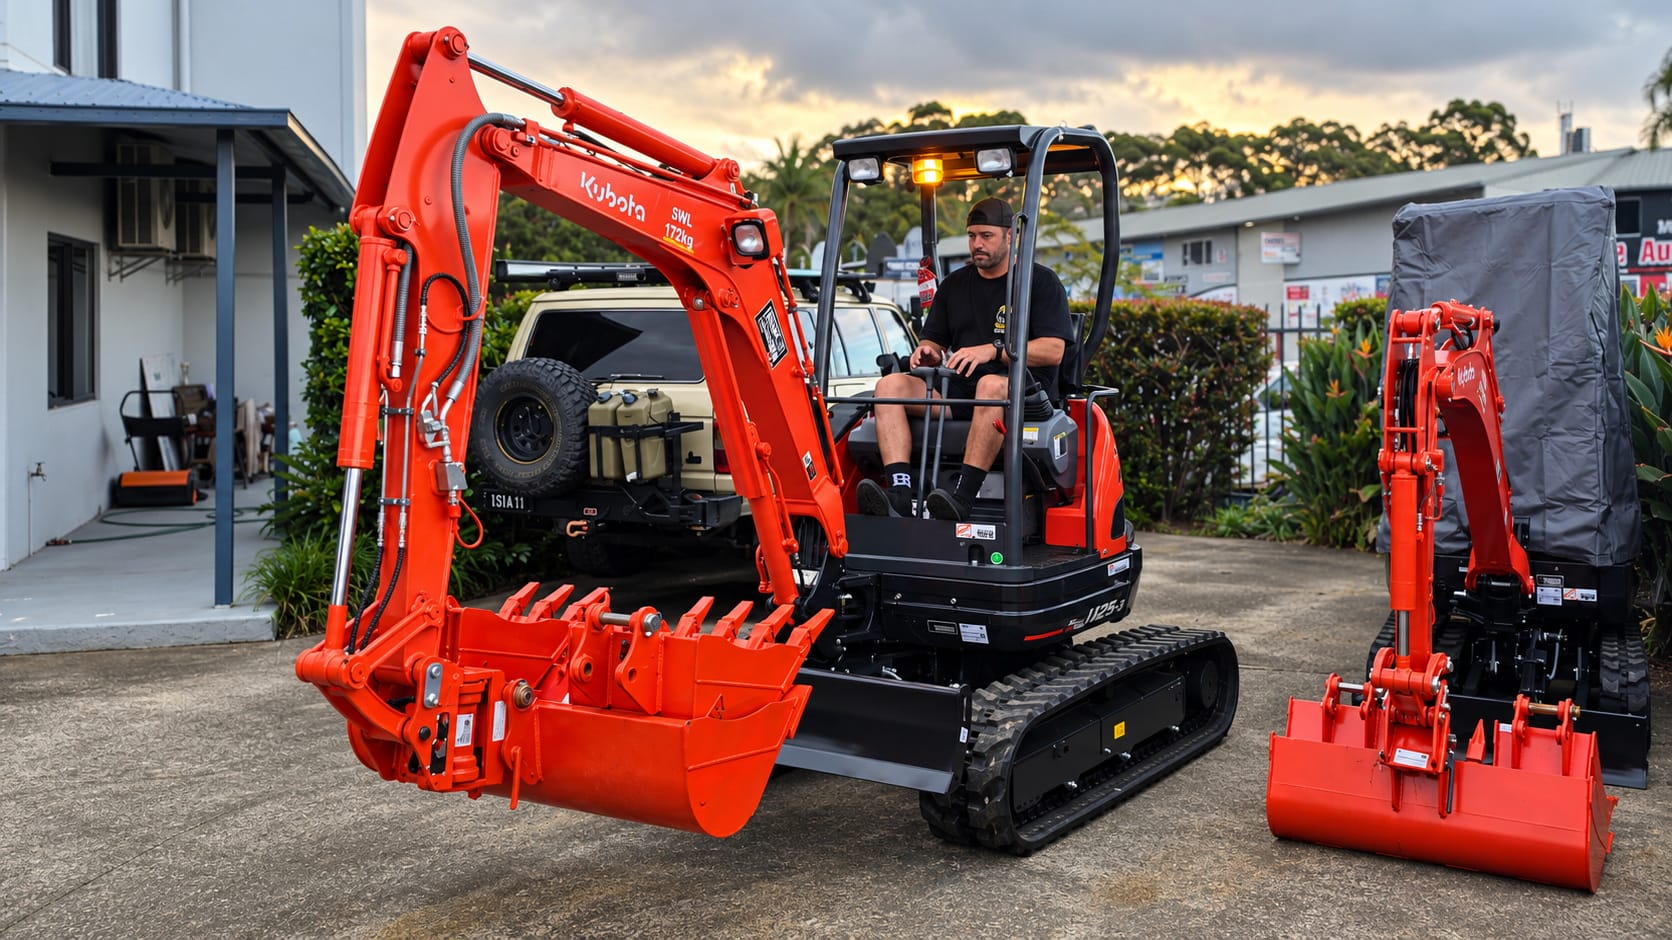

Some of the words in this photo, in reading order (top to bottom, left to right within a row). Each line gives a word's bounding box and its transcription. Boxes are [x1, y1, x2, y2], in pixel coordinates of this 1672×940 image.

[580, 171, 646, 222] Kubota
[671, 206, 693, 228] SWL
[664, 223, 694, 250] 172kg
